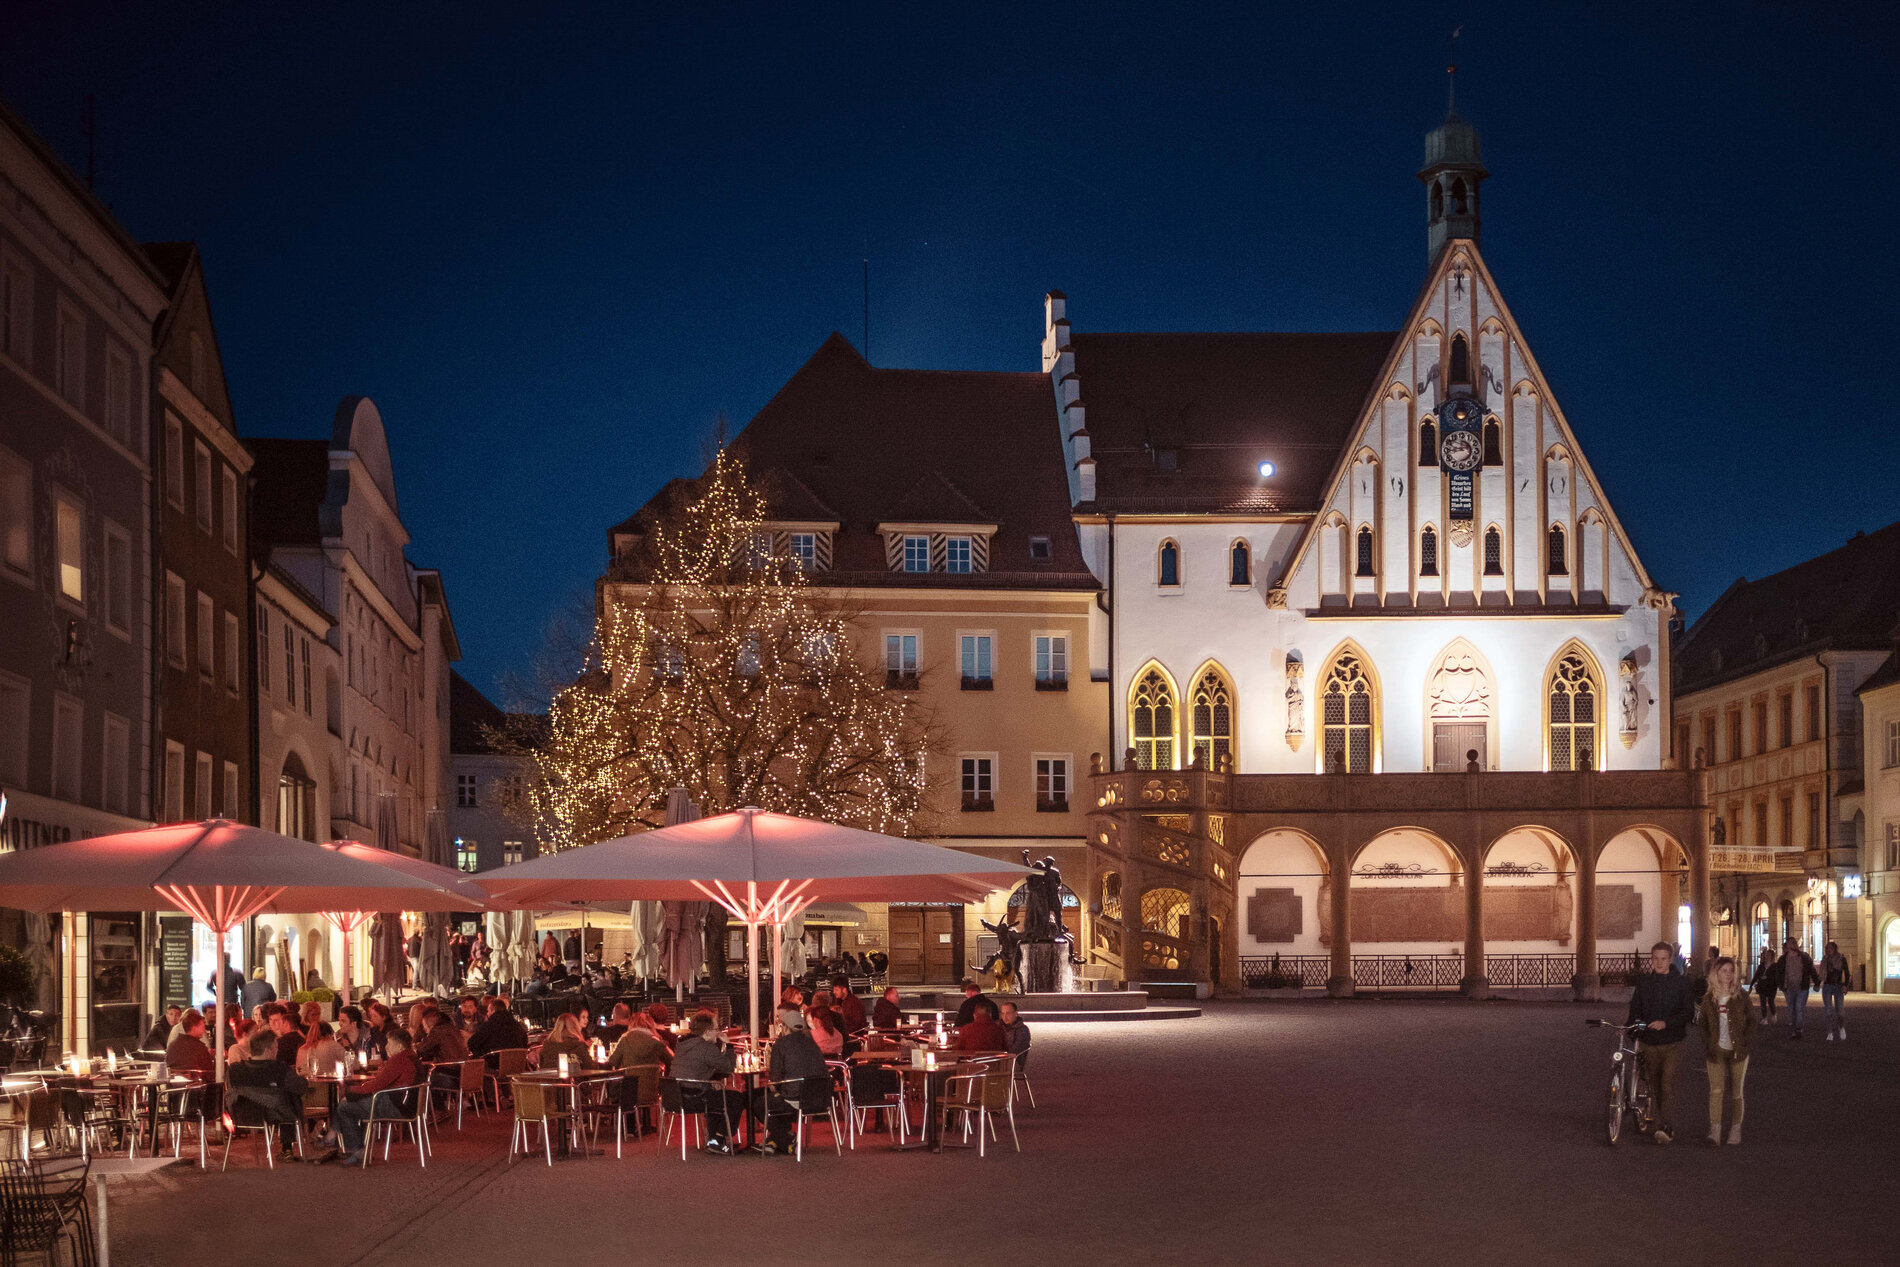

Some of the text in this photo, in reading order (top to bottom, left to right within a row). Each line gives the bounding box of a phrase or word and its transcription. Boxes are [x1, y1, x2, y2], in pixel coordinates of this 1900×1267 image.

[1718, 854, 1730, 862] 26.
[1738, 854, 1750, 863] 28.
[1752, 854, 1775, 864] APRIL
